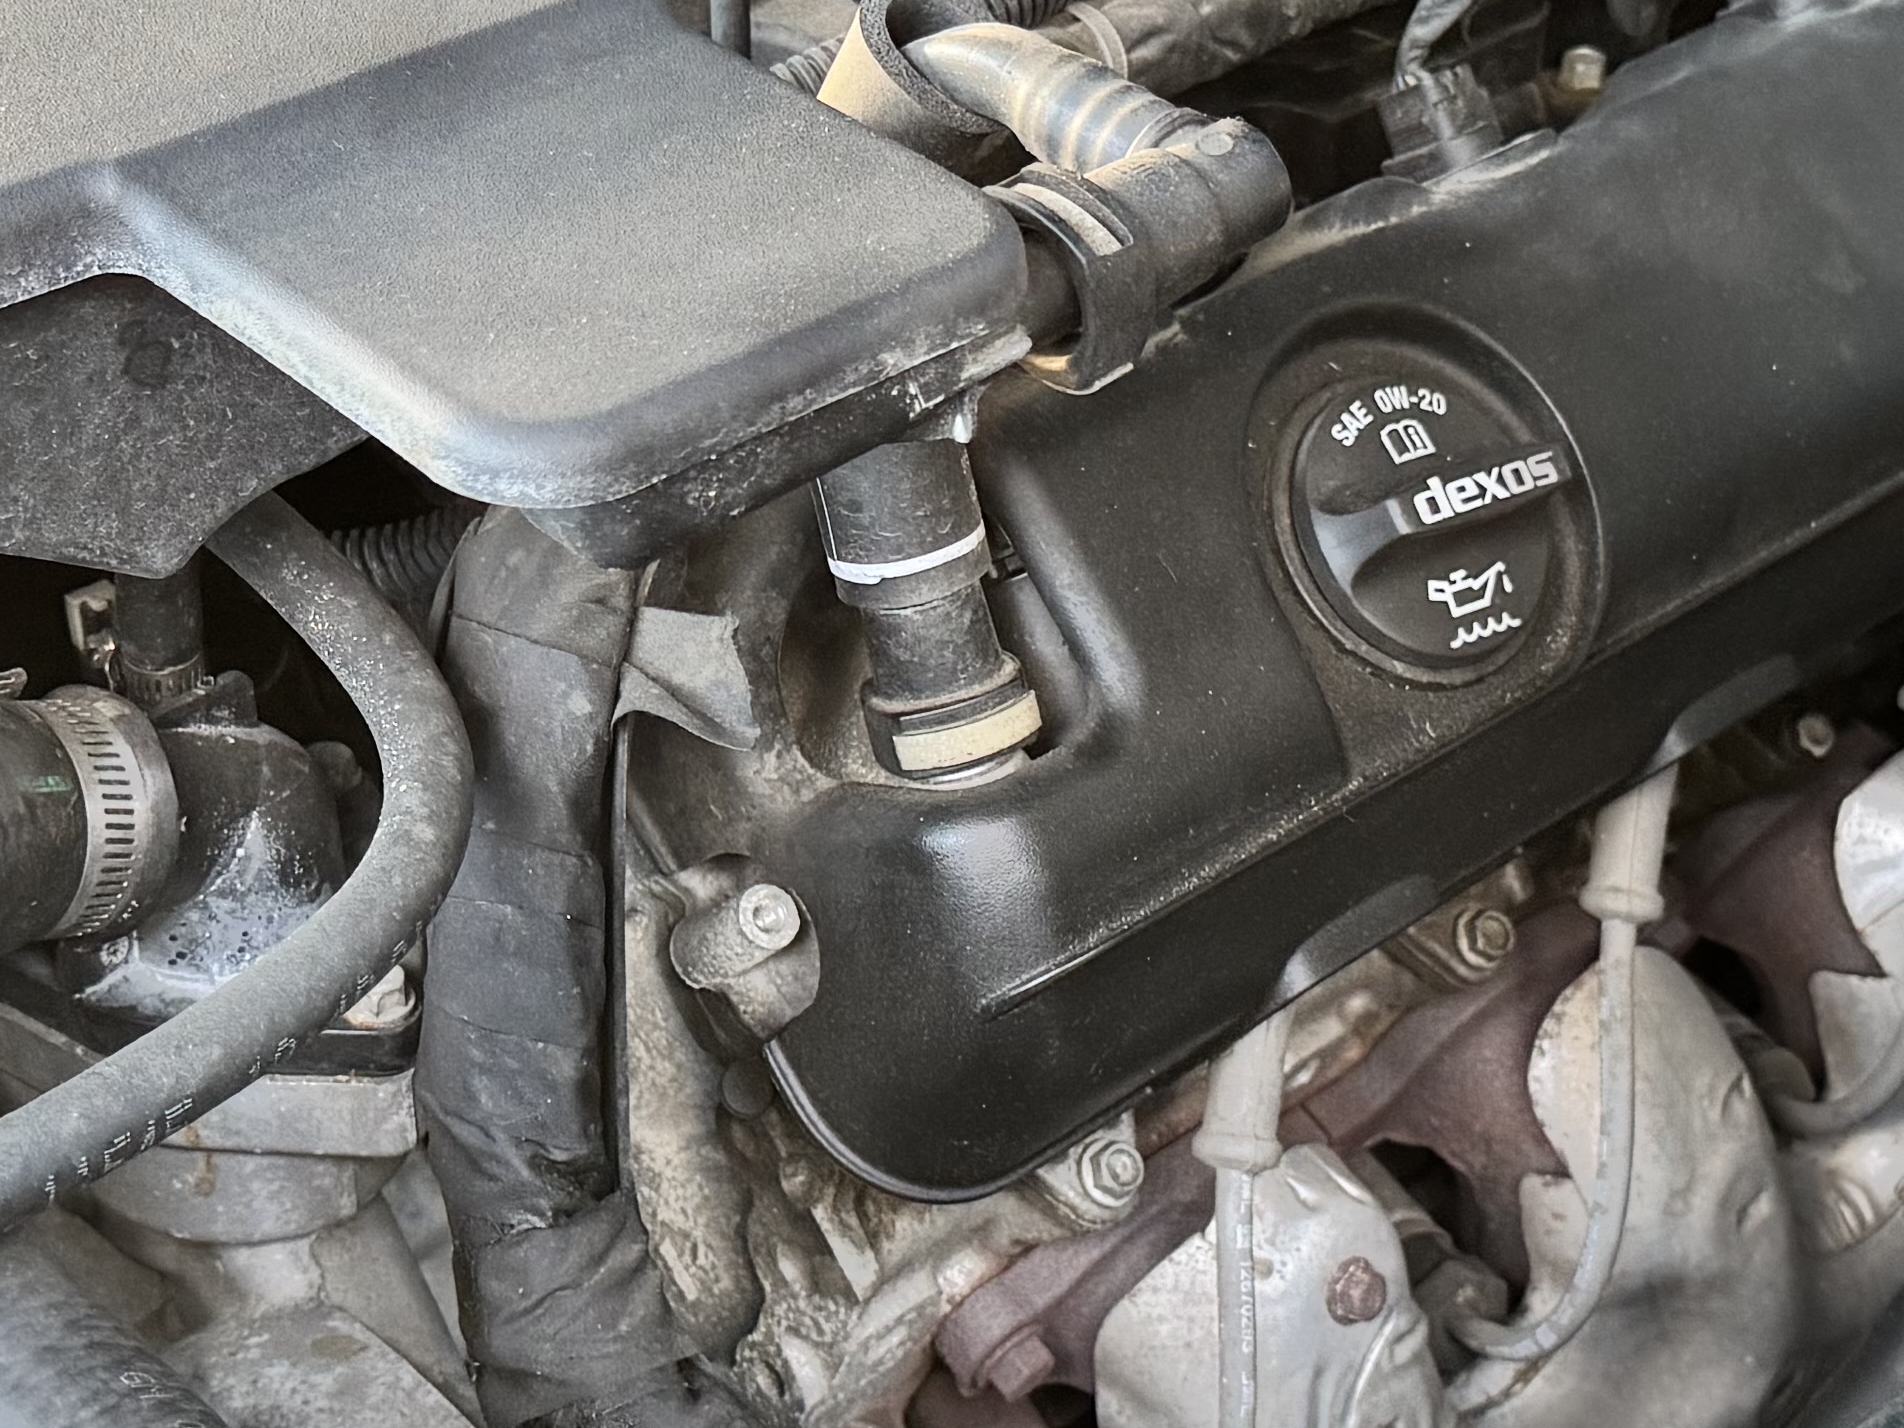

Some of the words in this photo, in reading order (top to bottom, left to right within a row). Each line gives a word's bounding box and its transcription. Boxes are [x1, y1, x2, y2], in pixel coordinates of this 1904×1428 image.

[1331, 399, 1374, 447] SAE
[1373, 384, 1447, 416] 0W-20
[1413, 451, 1558, 525] dexos
